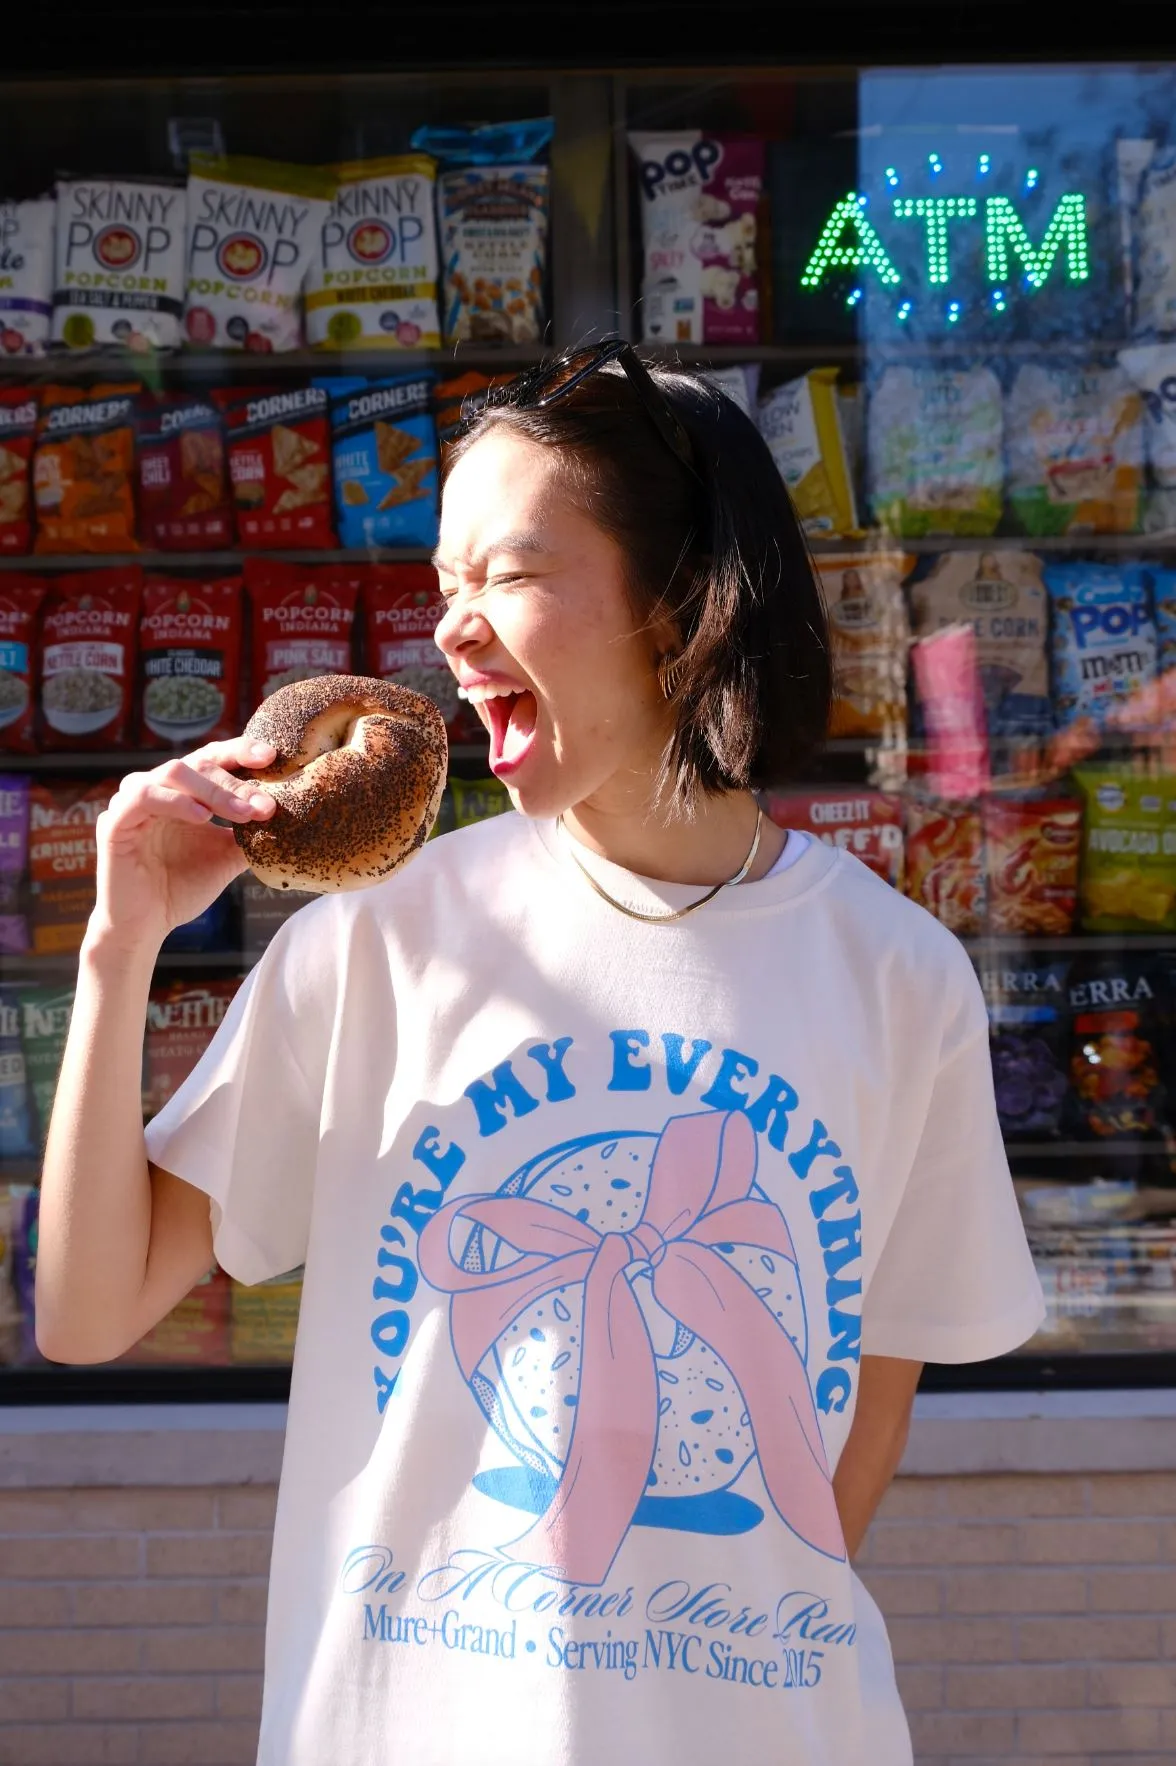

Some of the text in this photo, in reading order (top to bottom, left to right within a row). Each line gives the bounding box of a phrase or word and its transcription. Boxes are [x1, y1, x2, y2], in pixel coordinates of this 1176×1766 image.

[72, 187, 175, 224] SKINNY
[198, 189, 309, 237] SKINNY
[66, 222, 171, 273] POP
[321, 216, 423, 268] POP
[801, 192, 1089, 288] ATM
[188, 224, 300, 286] POP
[66, 271, 167, 292] POPCORN
[324, 266, 427, 285] POPCORN
[246, 387, 327, 423] CORNERS
[348, 380, 428, 420] CORNERS
[43, 609, 131, 629] POPCORN
[140, 613, 230, 632] POPCORN
[262, 605, 356, 624] POPCORN
[375, 605, 446, 626] POPCO
[153, 628, 212, 641] INDIANA
[279, 620, 340, 634] INDIANA
[391, 621, 438, 635] INDIA
[991, 617, 1039, 637] CORN
[174, 656, 222, 677] CHEDDAR
[273, 649, 346, 668] PINK SALT
[422, 649, 446, 667] SA
[820, 824, 903, 852] FF'D
[31, 839, 98, 860] KRINKL
[53, 857, 87, 872] CUT
[979, 971, 1063, 994] ERRA
[1069, 975, 1156, 1007] ERRA
[371, 1029, 863, 1417] YOU'RE MY EVERYTHING
[342, 1545, 857, 1647] On A Corner Store Run
[363, 1603, 517, 1660] Mure+Grand
[546, 1626, 639, 1681] Serving
[641, 1629, 702, 1674] NYC
[706, 1641, 779, 1688] Since
